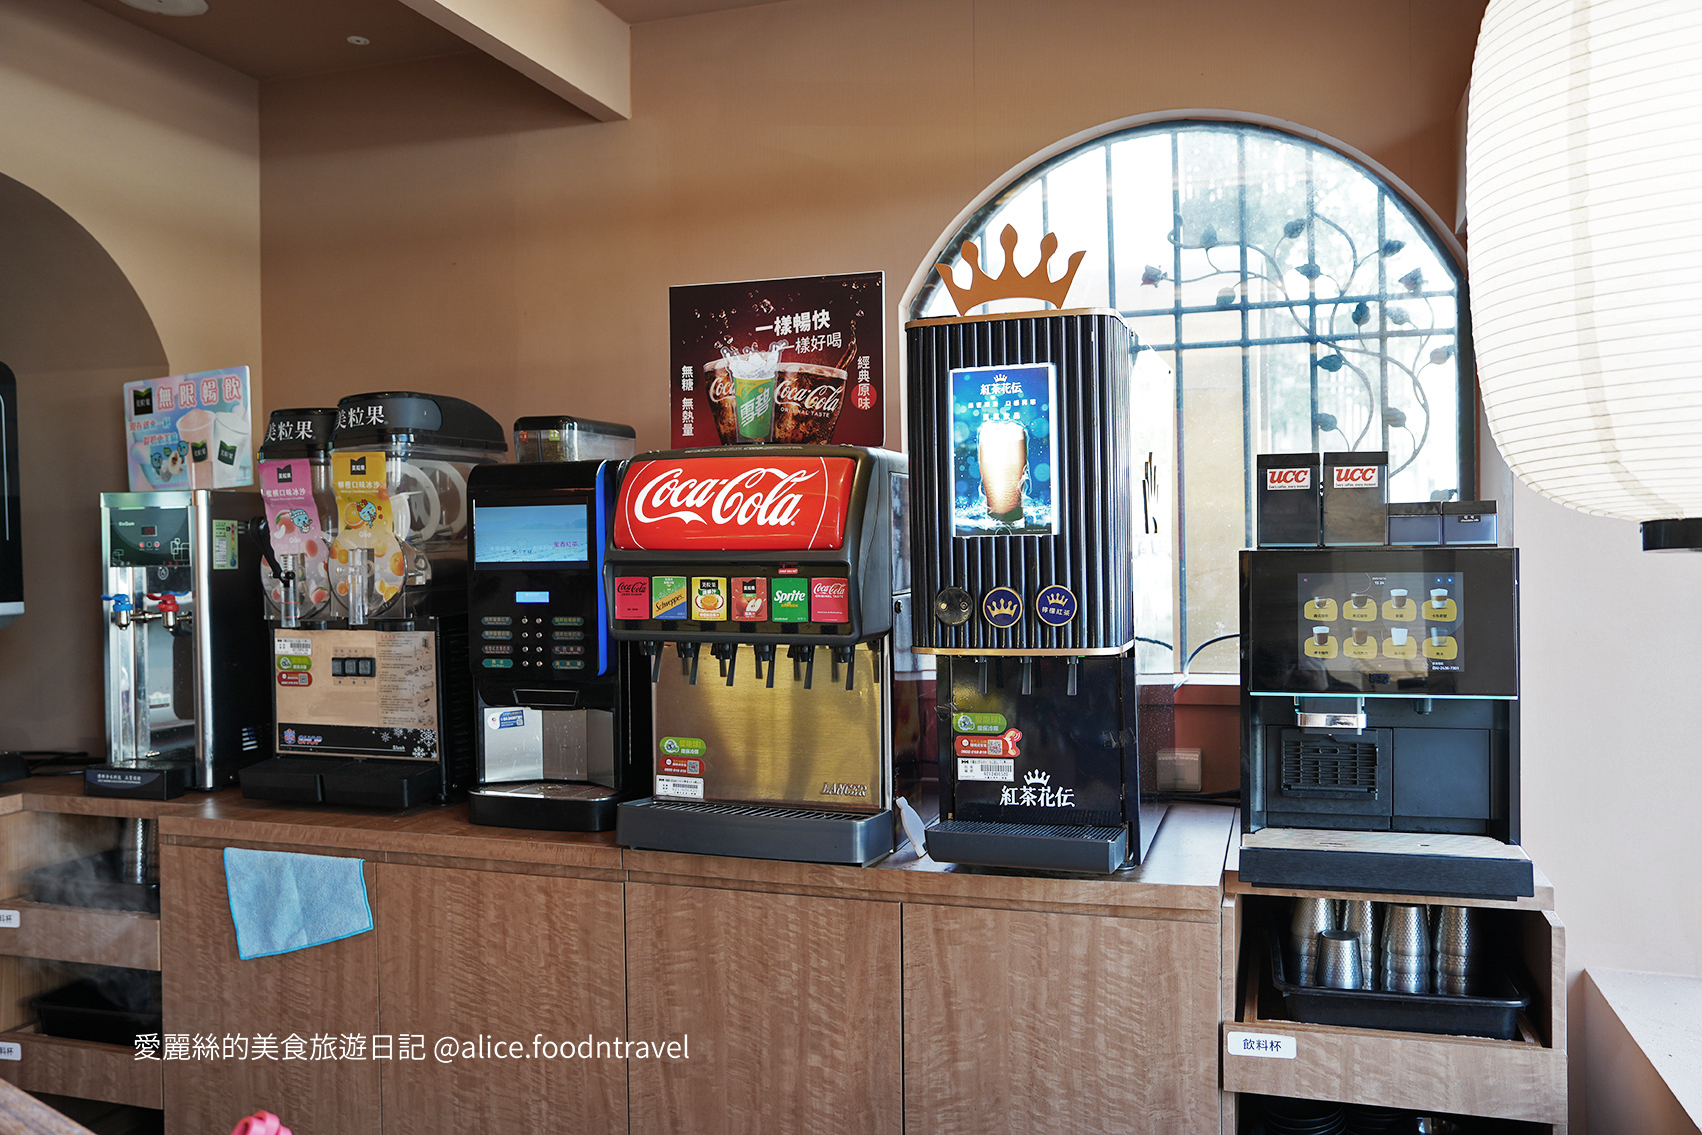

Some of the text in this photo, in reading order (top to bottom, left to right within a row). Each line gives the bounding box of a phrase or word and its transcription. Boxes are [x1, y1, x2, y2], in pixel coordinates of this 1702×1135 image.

[755, 308, 831, 337] 一樣暢快
[781, 332, 842, 354] 一樣好喝
[681, 365, 694, 391] 無糖
[856, 355, 871, 410] 經典原味
[980, 382, 1023, 395] 紅茶花伝
[157, 375, 242, 410] 無限暢飲
[774, 380, 844, 412] Coca-Cola
[681, 397, 695, 436] 無熱量
[740, 387, 771, 427] 雪碧
[811, 410, 830, 418] TASTE
[1269, 470, 1308, 483] UCC
[1335, 468, 1376, 482] UCC
[634, 468, 820, 526] Coca-Cola
[774, 590, 806, 603] Sprite
[821, 782, 868, 797] LANCER
[1000, 785, 1076, 808] 紅茶花伝
[1242, 1038, 1282, 1052] 飲料杯
